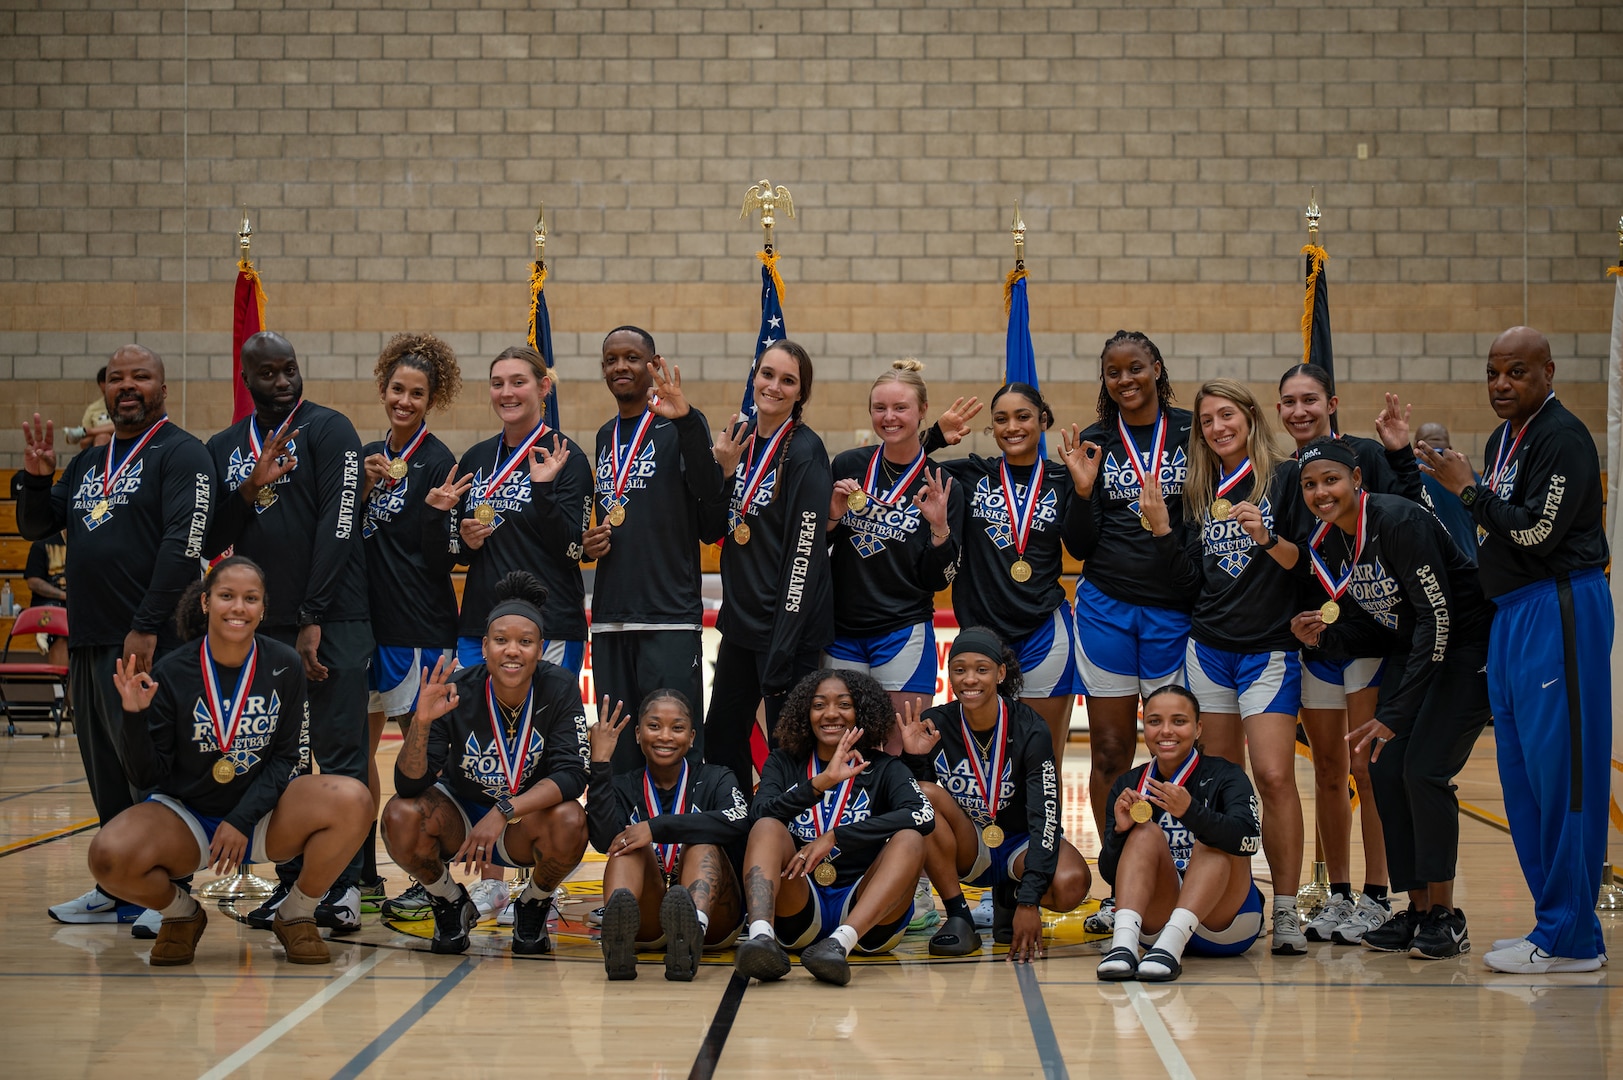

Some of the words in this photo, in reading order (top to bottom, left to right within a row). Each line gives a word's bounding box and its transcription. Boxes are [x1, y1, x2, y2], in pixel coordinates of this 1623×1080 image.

[344, 451, 359, 489] 3-PEAT
[596, 460, 657, 481] FOCE
[1103, 466, 1188, 489] FOCE
[72, 477, 142, 500] FOCE
[73, 494, 129, 510] BASKBALL
[195, 472, 210, 512] 3-PEAT
[1110, 483, 1184, 500] BASKALL
[1543, 474, 1567, 520] 3-PEAT
[335, 490, 356, 539] CHAMPS
[841, 515, 907, 543] BASKETBALL
[851, 503, 921, 534] ORCE
[972, 508, 1046, 532] BASKELL
[185, 512, 207, 559] CHAMPS
[796, 511, 817, 557] 3-PEAT
[1204, 535, 1259, 556] BASKETBA
[1510, 518, 1553, 546] CHAMPS
[785, 556, 809, 613] CHAMPS
[1416, 564, 1448, 608] 3-PEAT
[1431, 608, 1450, 662] CHAMPS
